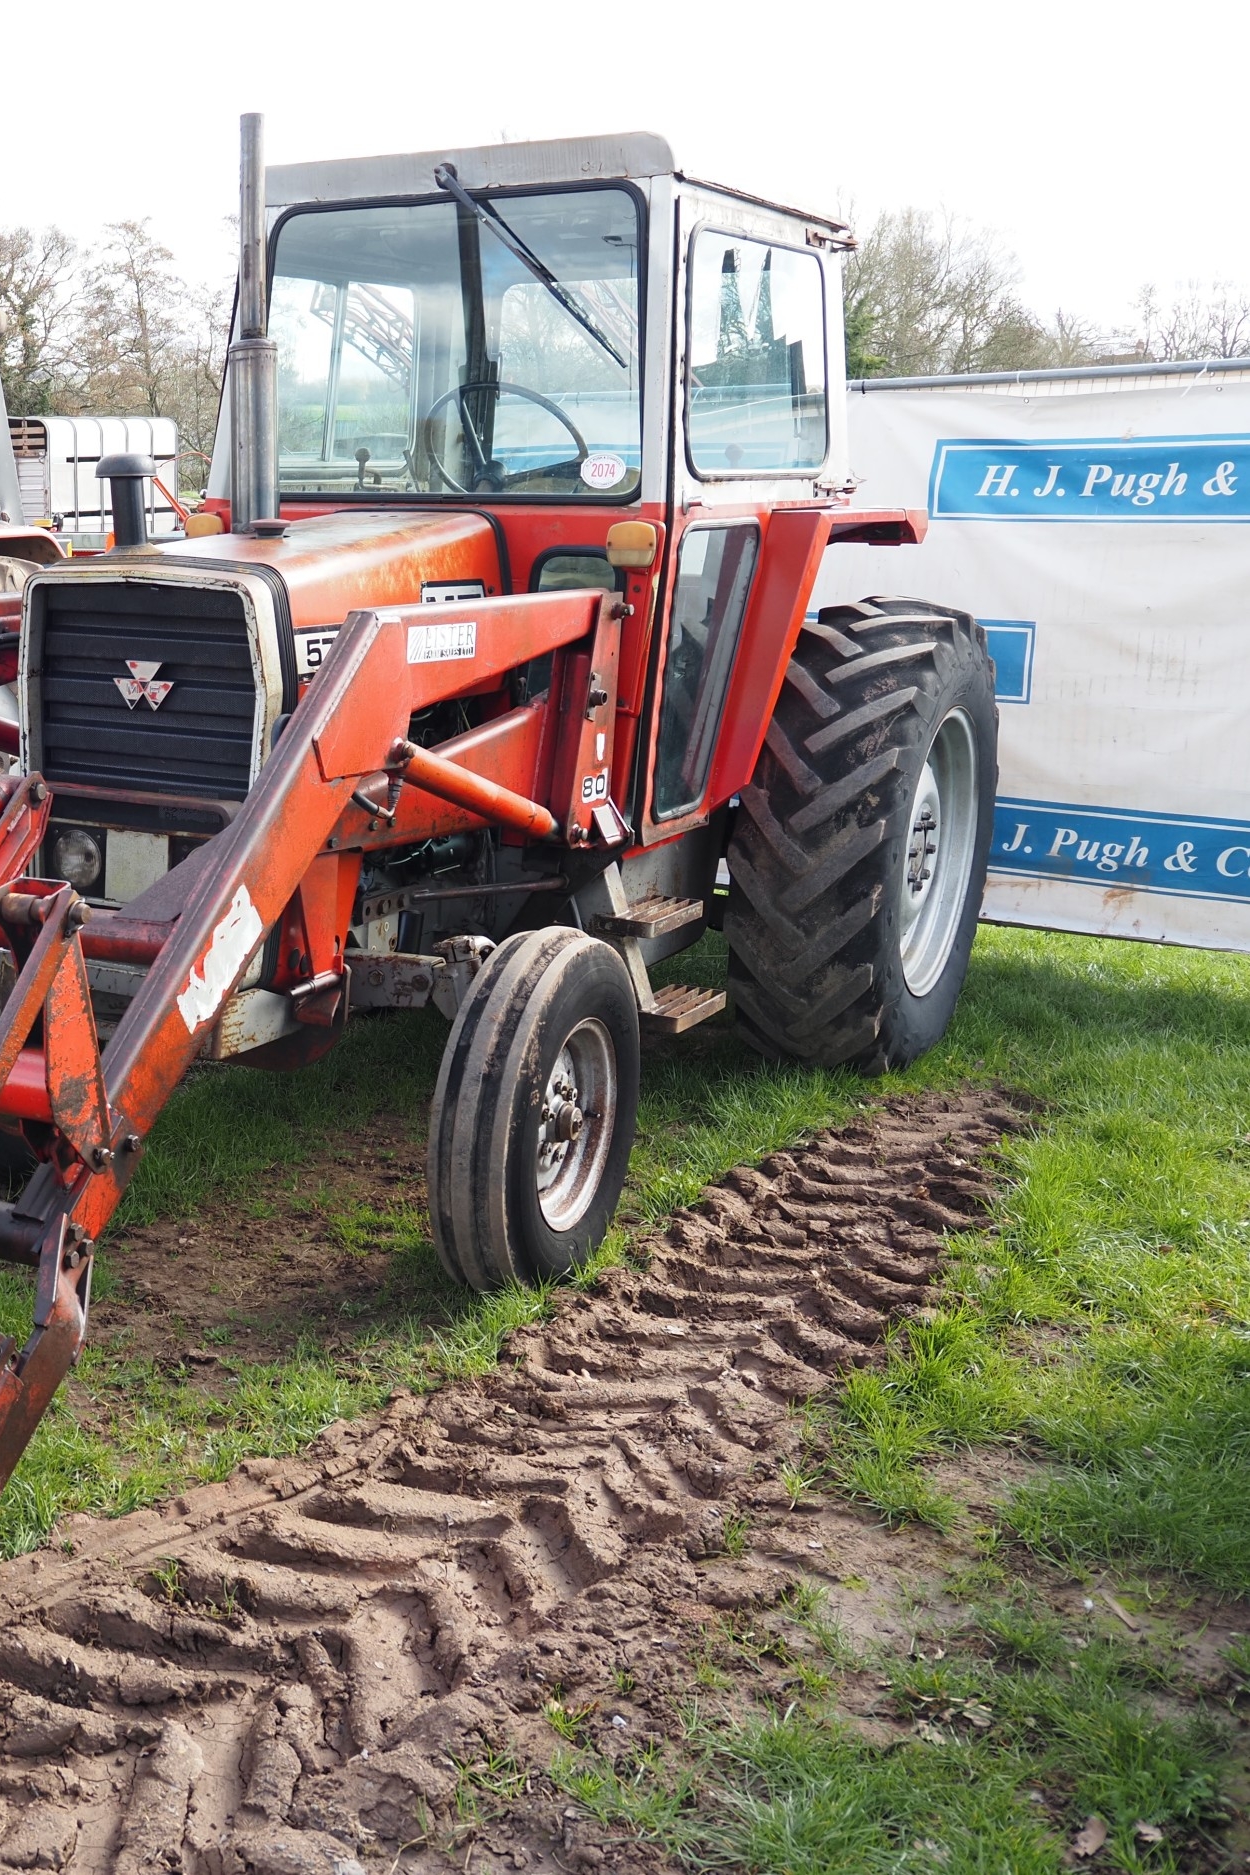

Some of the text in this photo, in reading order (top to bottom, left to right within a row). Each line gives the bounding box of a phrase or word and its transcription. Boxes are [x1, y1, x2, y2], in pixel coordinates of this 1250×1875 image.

[591, 462, 616, 478] 2074
[973, 460, 1239, 507] H. J. Pugh &
[425, 624, 474, 649] LISTER
[582, 774, 606, 798] 80
[1002, 823, 1250, 878] J. Pugh & C
